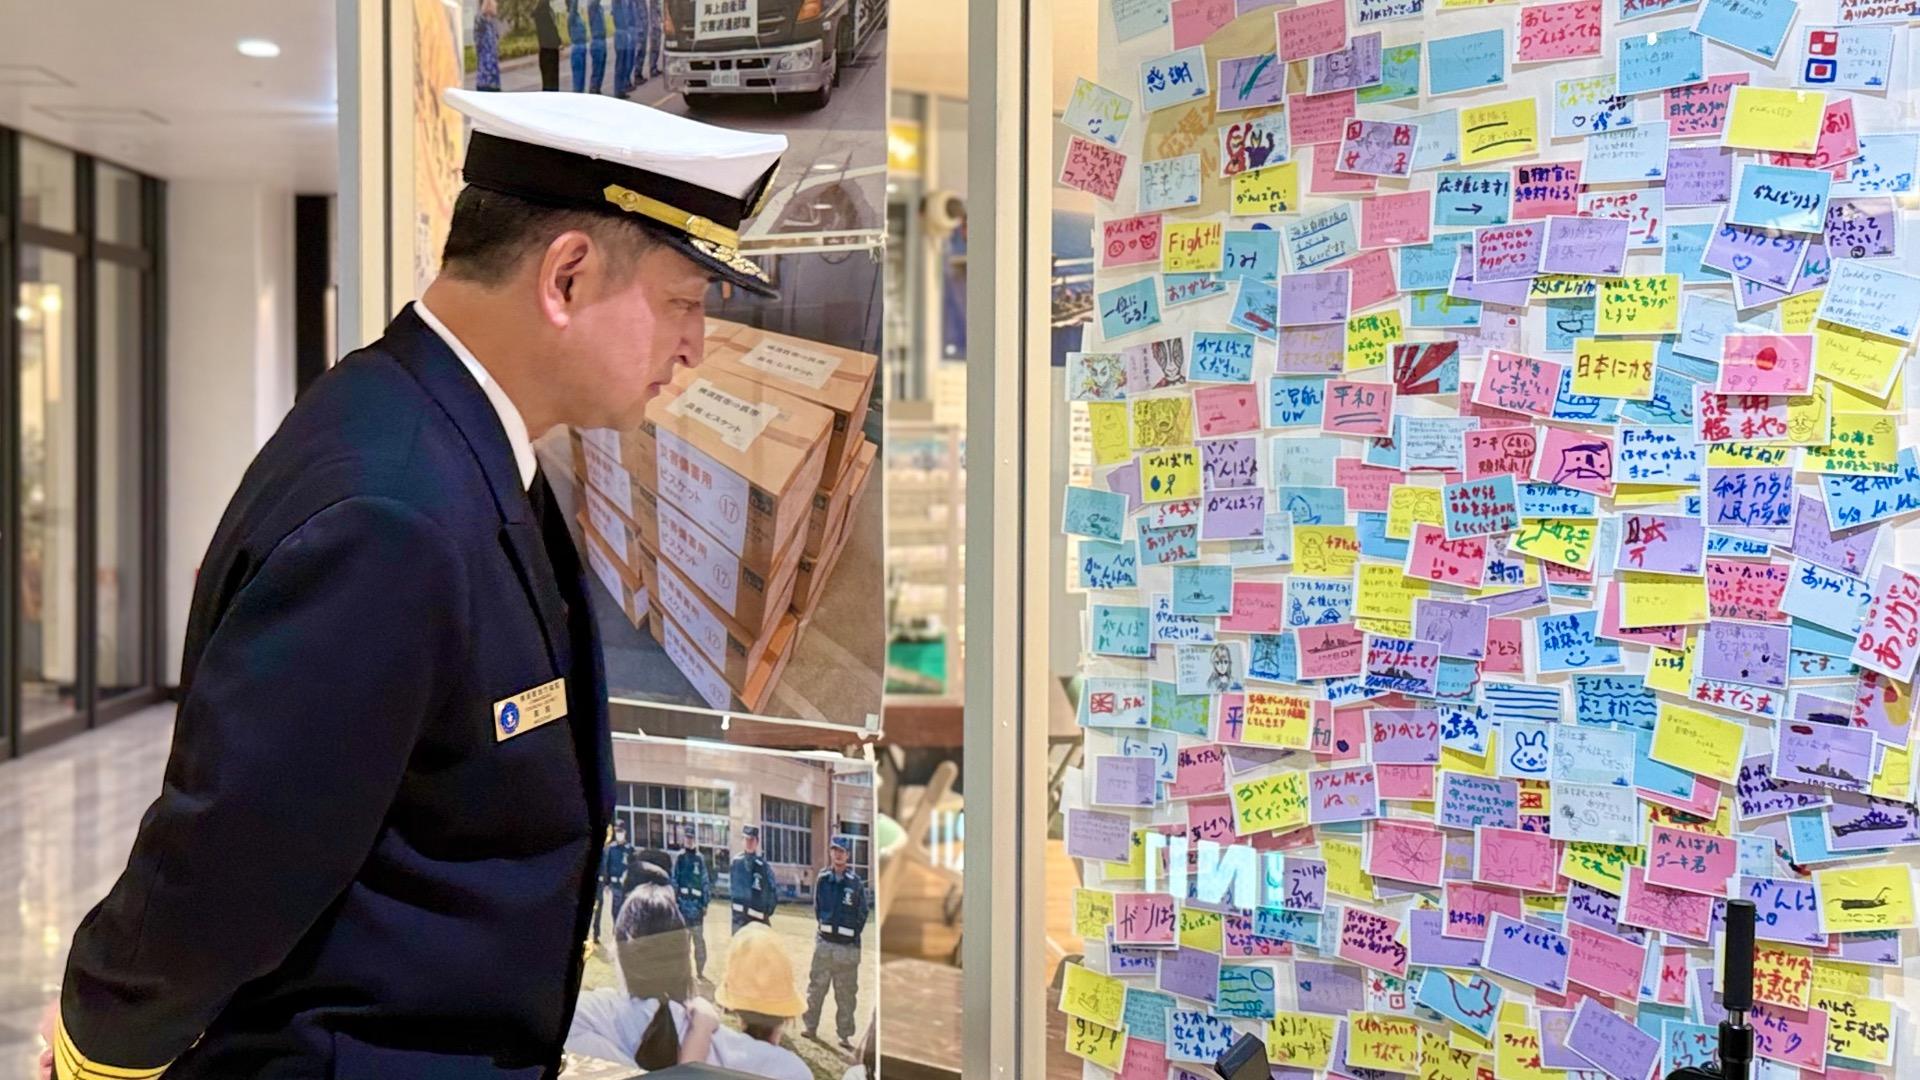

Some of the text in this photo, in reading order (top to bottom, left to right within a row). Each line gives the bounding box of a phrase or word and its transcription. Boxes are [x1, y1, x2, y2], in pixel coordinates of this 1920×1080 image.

[1146, 61, 1193, 94] 感謝
[1519, 165, 1577, 183] 自衛官に
[1437, 176, 1509, 195] 応援します!
[1168, 222, 1220, 256] Fight!!
[1373, 721, 1438, 743] ありがとう
